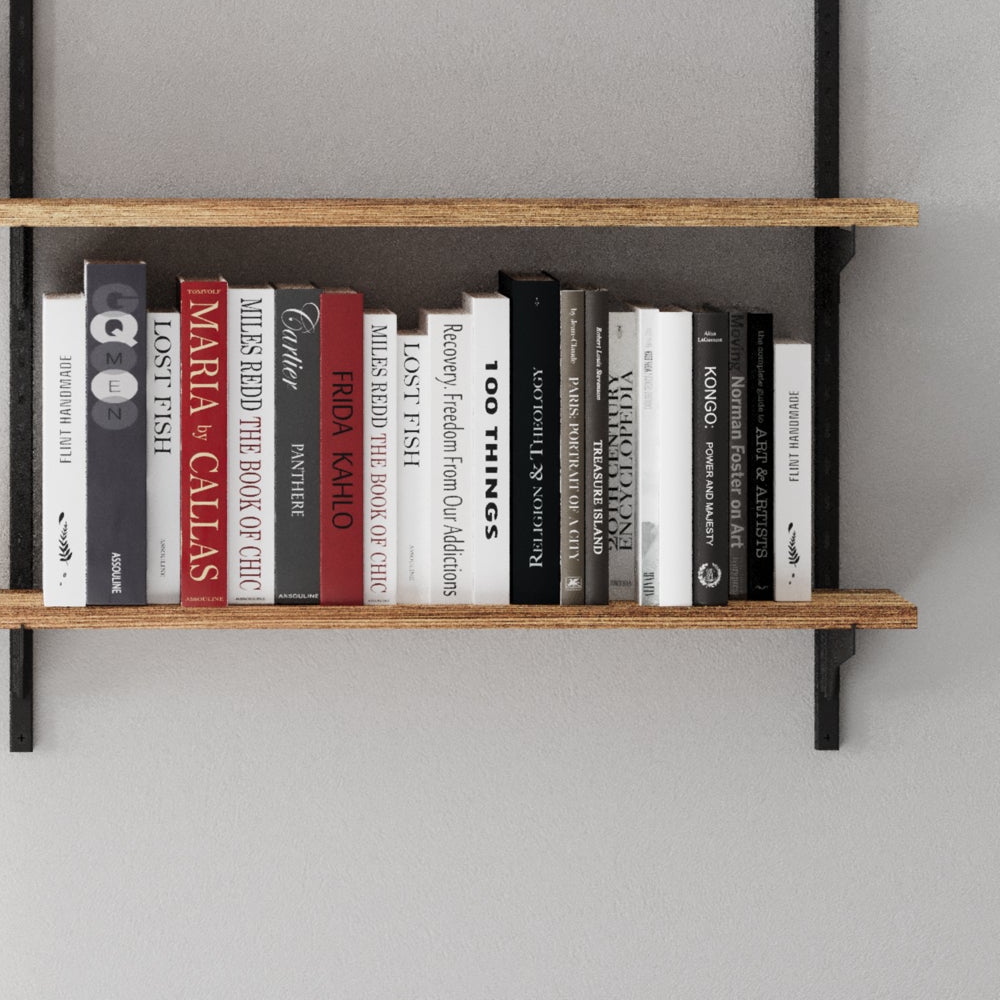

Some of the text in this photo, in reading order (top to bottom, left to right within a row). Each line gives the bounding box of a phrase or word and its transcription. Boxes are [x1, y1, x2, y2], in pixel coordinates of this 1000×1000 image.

[239, 298, 262, 356] MILES
[281, 302, 320, 391] Cartier
[371, 325, 388, 377] MILES
[729, 314, 745, 372] Moving
[757, 330, 765, 344] the
[154, 319, 172, 455] LOST FISH
[239, 362, 262, 411] REDD
[756, 346, 766, 387] complete
[59, 354, 72, 464] FLINT HANDMADE
[371, 382, 388, 428] REDD
[404, 343, 420, 467] LOST FISH
[443, 393, 464, 452] Freedom
[704, 366, 717, 429] KONGO:
[730, 375, 745, 440] Norman
[190, 300, 219, 582] MARIA by CALLAS
[239, 416, 262, 453] THE
[332, 371, 353, 530] FRIDA KAHLO
[371, 433, 388, 467] THE
[485, 360, 499, 540] 100 THINGS
[620, 370, 633, 550] ENCYCLOPEDIA
[788, 390, 799, 482] FLINT HANDMADE
[239, 460, 262, 511] BOOK
[291, 443, 304, 518] PANTHERE
[371, 473, 388, 520] BOOK
[443, 457, 464, 491] From
[529, 462, 543, 482] &
[568, 377, 579, 561] PARIS: PORTRAIT OF A CITY
[593, 439, 603, 554] TREASURE ISLAND
[705, 441, 714, 547] POWER AND MAJESTY
[730, 444, 745, 494] Foster
[756, 427, 768, 558] ART & ARTISTS
[239, 519, 262, 540] OF
[371, 525, 388, 547] OF
[443, 495, 464, 522] Our
[730, 499, 742, 519] on
[730, 523, 745, 549] Art
[112, 552, 121, 594] ASSOULINE
[239, 544, 262, 590] CHIC
[371, 552, 388, 593] CHIC
[443, 524, 464, 597] Addictions
